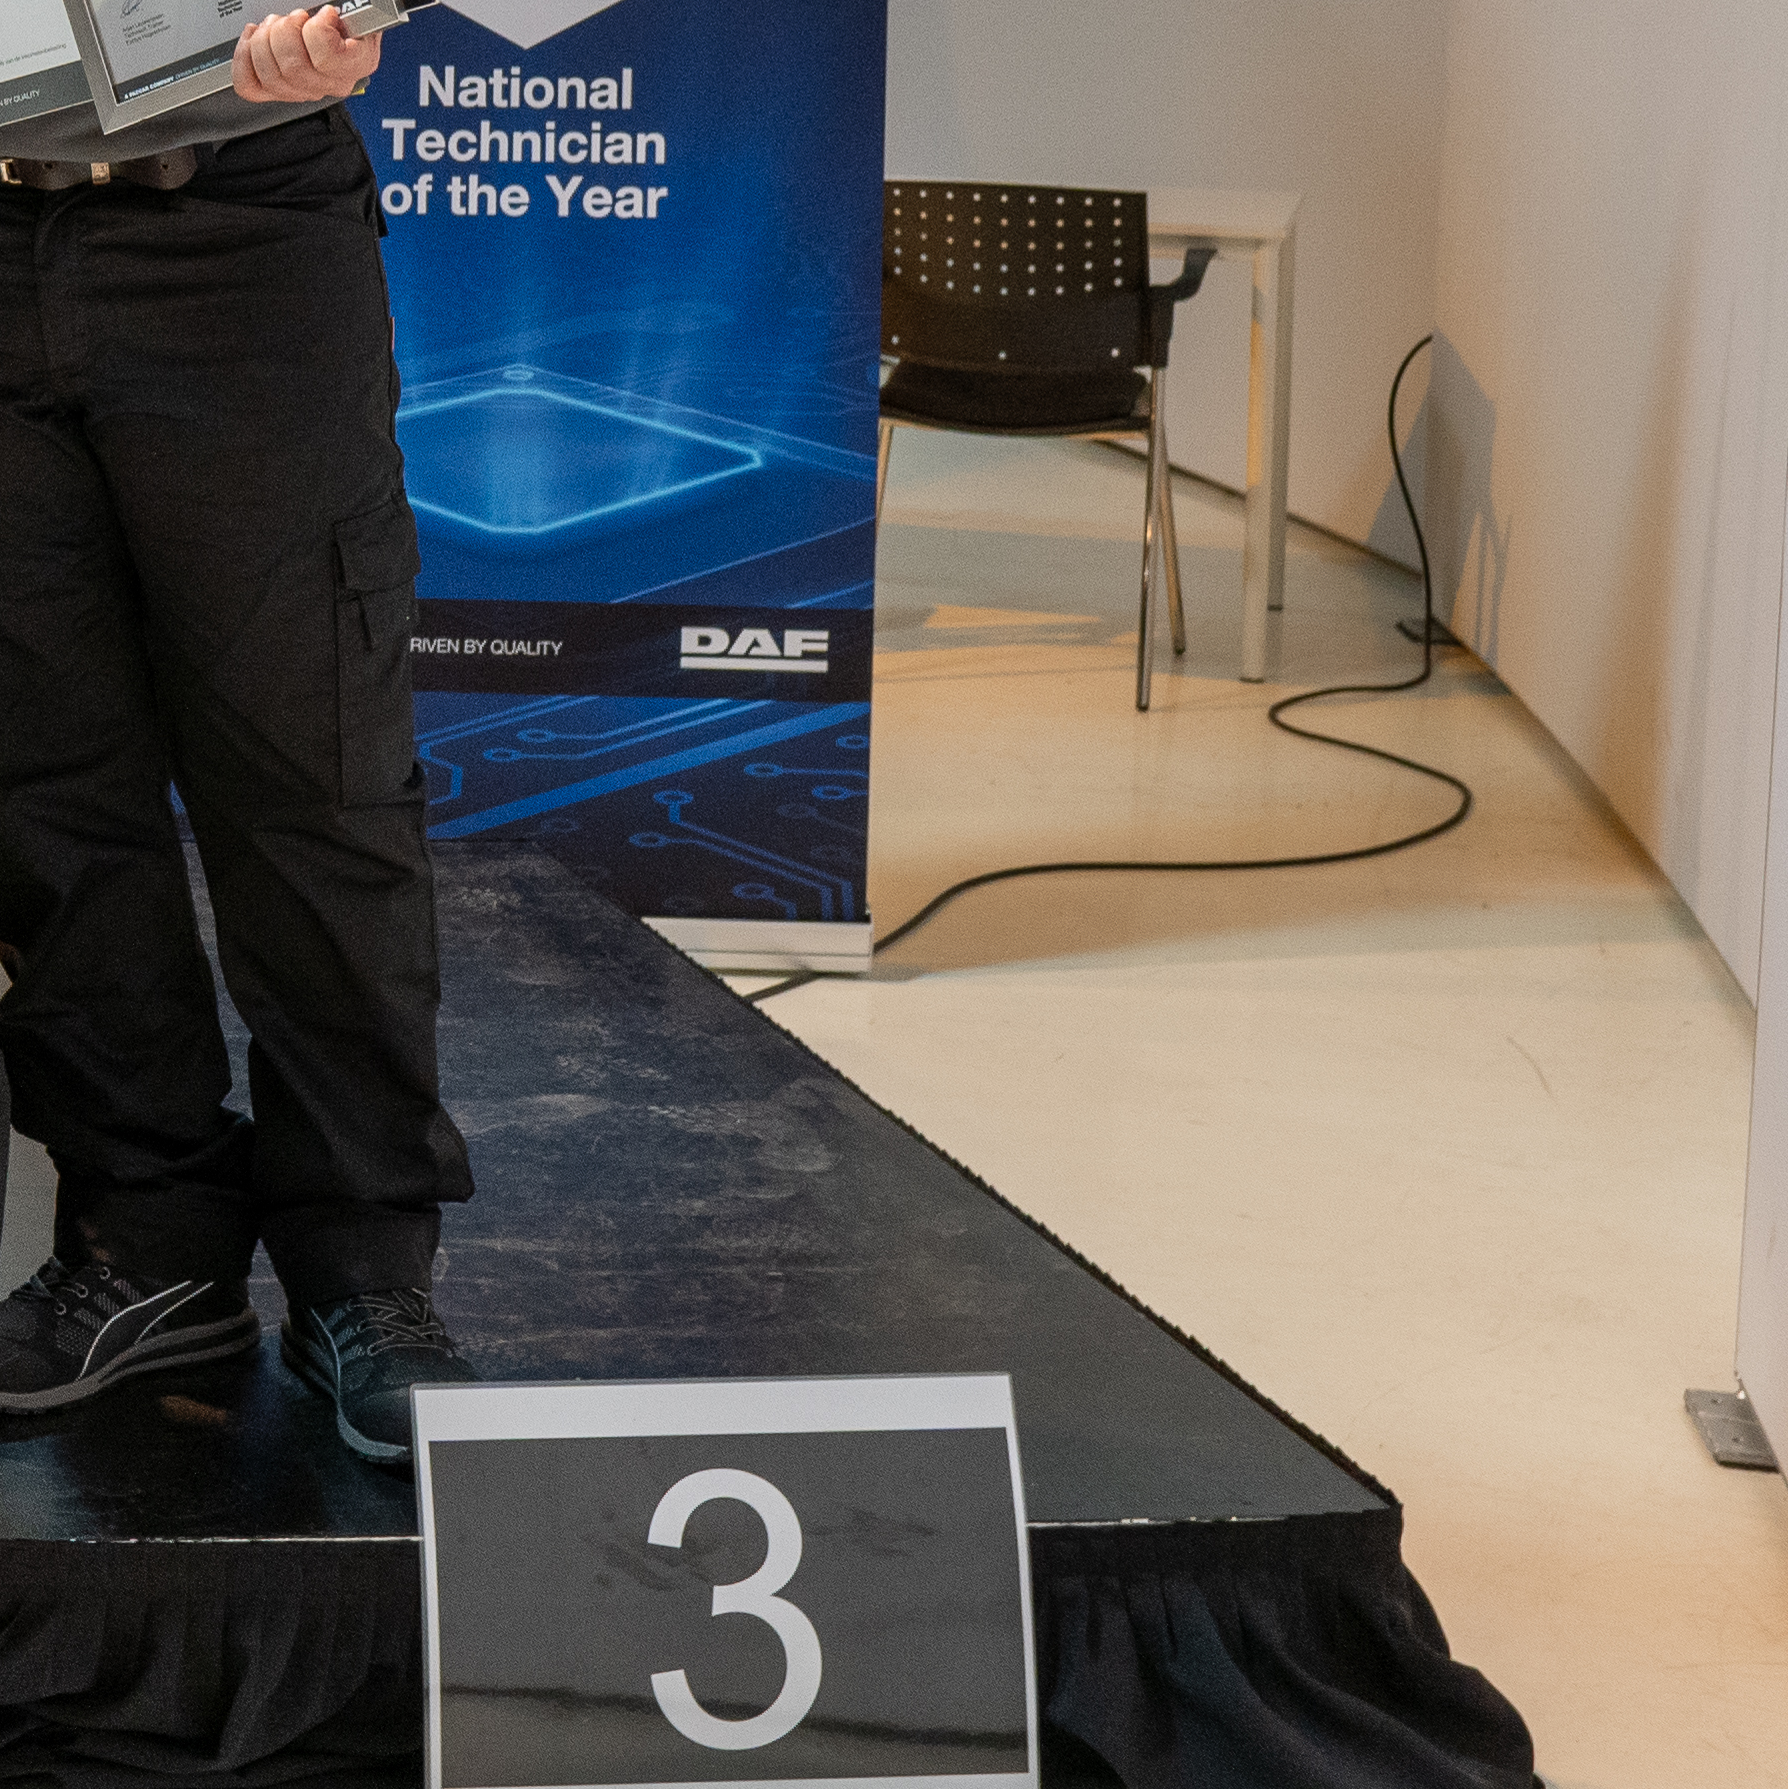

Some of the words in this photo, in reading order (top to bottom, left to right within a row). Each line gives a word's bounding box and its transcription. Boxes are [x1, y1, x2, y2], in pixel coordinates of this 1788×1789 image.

[419, 65, 633, 110] National
[381, 118, 666, 165] Technician
[381, 173, 433, 215] of
[446, 174, 530, 217] the
[545, 175, 669, 219] Year
[409, 637, 459, 655] RIVEN
[464, 638, 487, 655] BY
[490, 639, 563, 656] QUALITY
[681, 626, 829, 658] DAF
[648, 1468, 822, 1750] 3
